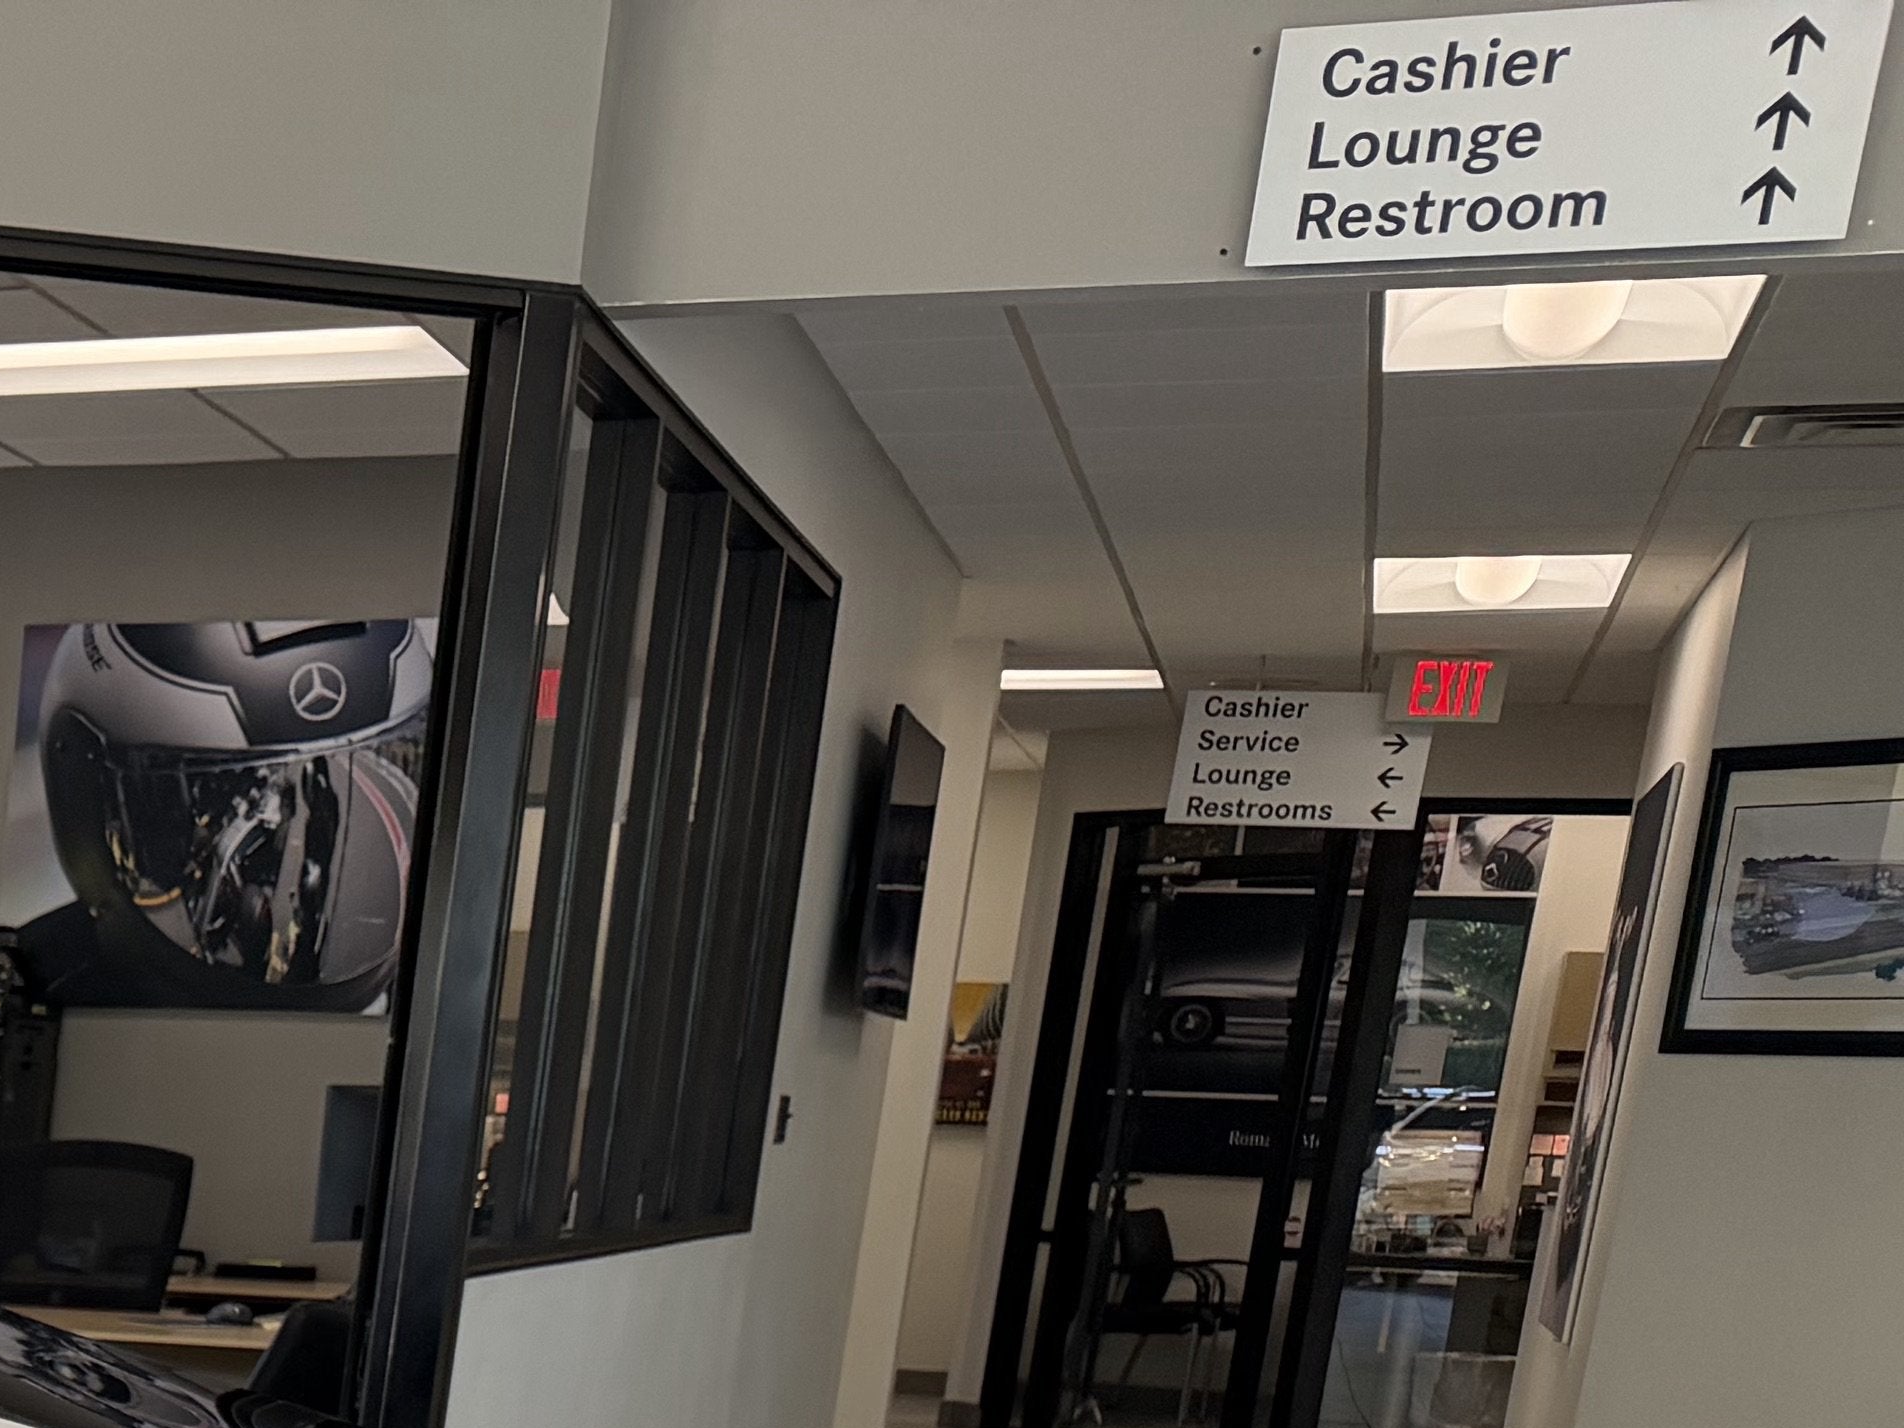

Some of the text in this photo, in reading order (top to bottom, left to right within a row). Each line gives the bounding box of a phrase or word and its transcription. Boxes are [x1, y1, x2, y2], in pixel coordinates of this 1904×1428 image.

[1322, 36, 1571, 98] Cashier
[1307, 121, 1542, 175] Lounge
[1295, 189, 1608, 241] Restroom
[1203, 695, 1310, 719] Cashier
[1407, 659, 1495, 718] EXIT
[1197, 729, 1300, 753] Service
[1192, 762, 1292, 791] Lounge
[1185, 795, 1334, 822] Restrooms
